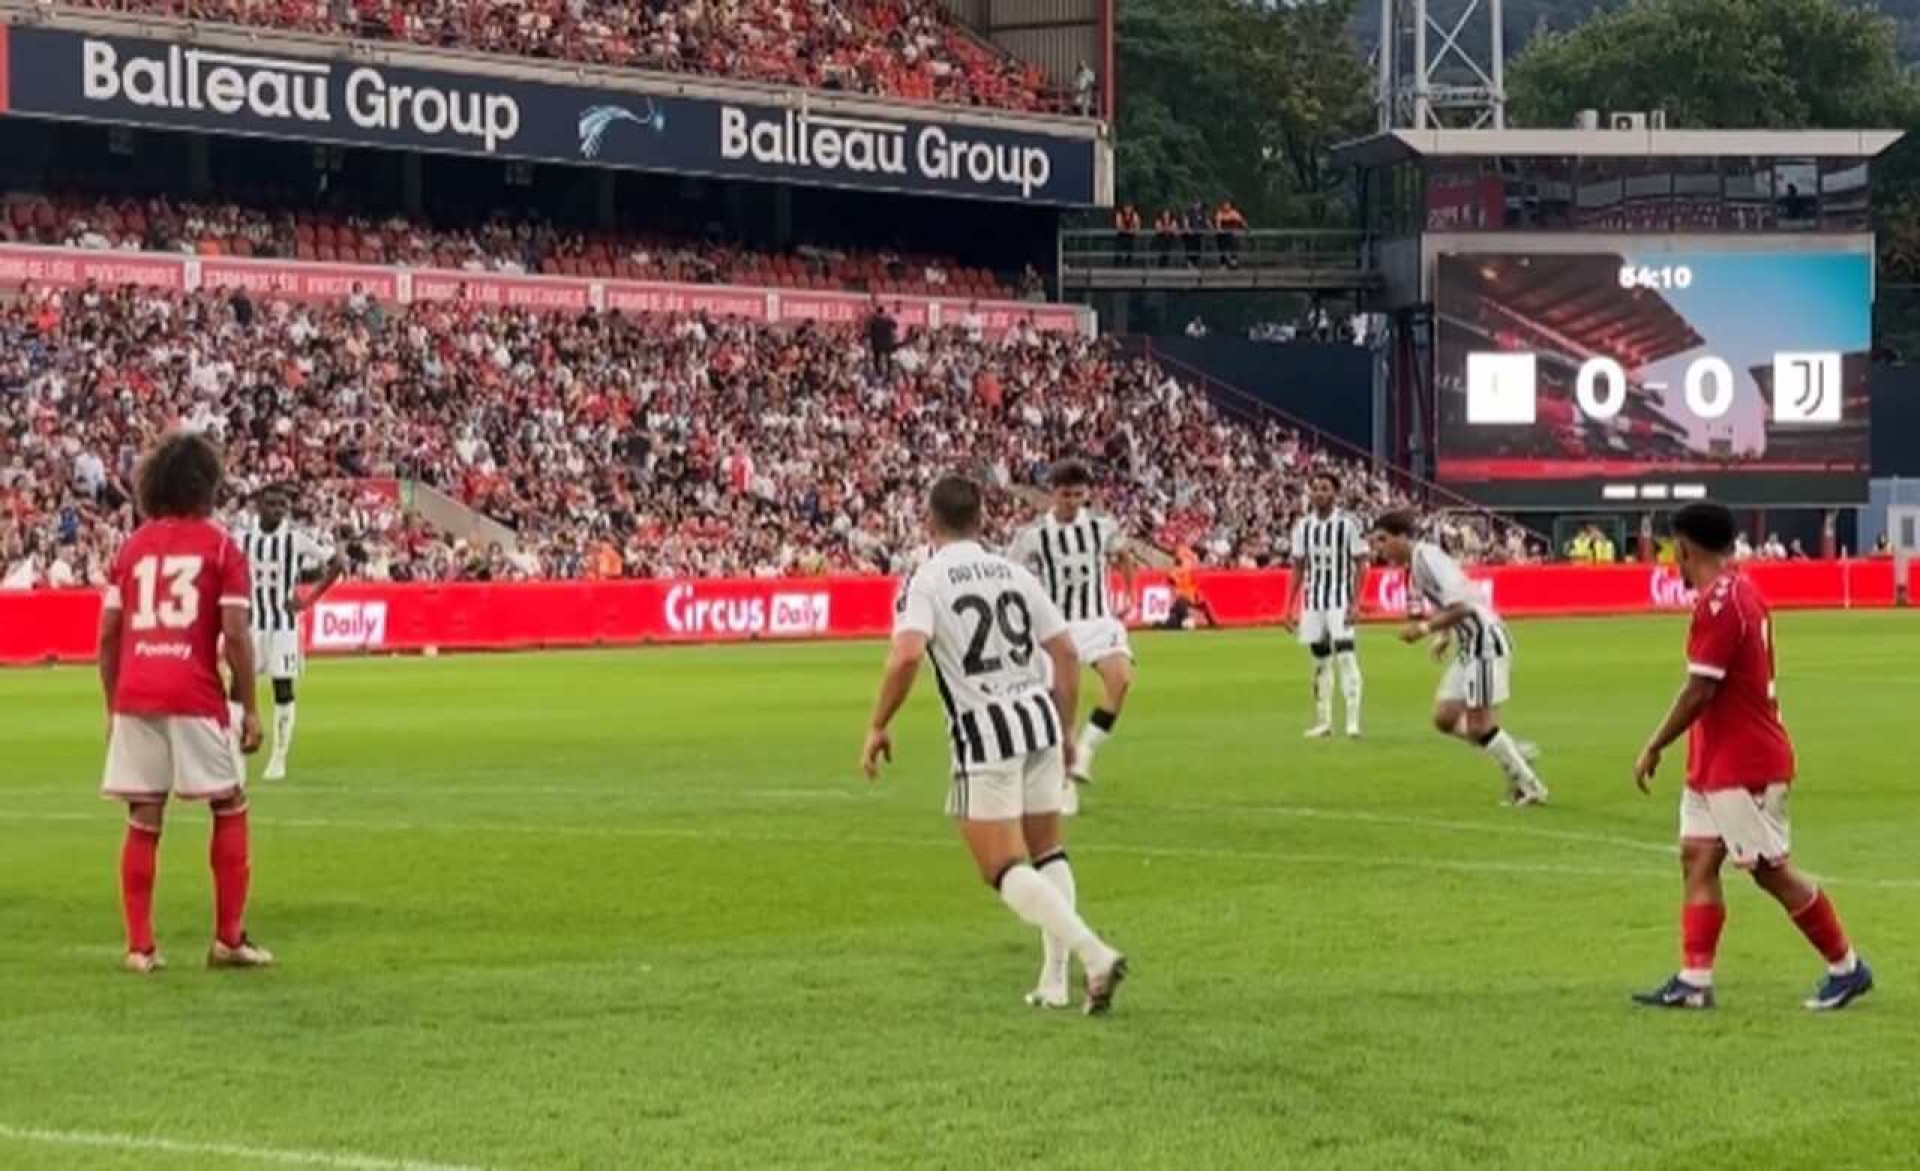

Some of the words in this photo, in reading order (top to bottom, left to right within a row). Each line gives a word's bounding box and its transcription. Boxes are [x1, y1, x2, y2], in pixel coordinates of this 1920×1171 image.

[345, 68, 520, 151] Group
[916, 127, 1051, 197] Group
[1577, 357, 1627, 420] 0
[1684, 357, 1735, 420] 0
[131, 555, 202, 630] 13
[322, 612, 378, 638] Daily
[665, 583, 764, 632] Circus
[952, 591, 1032, 676] 29
